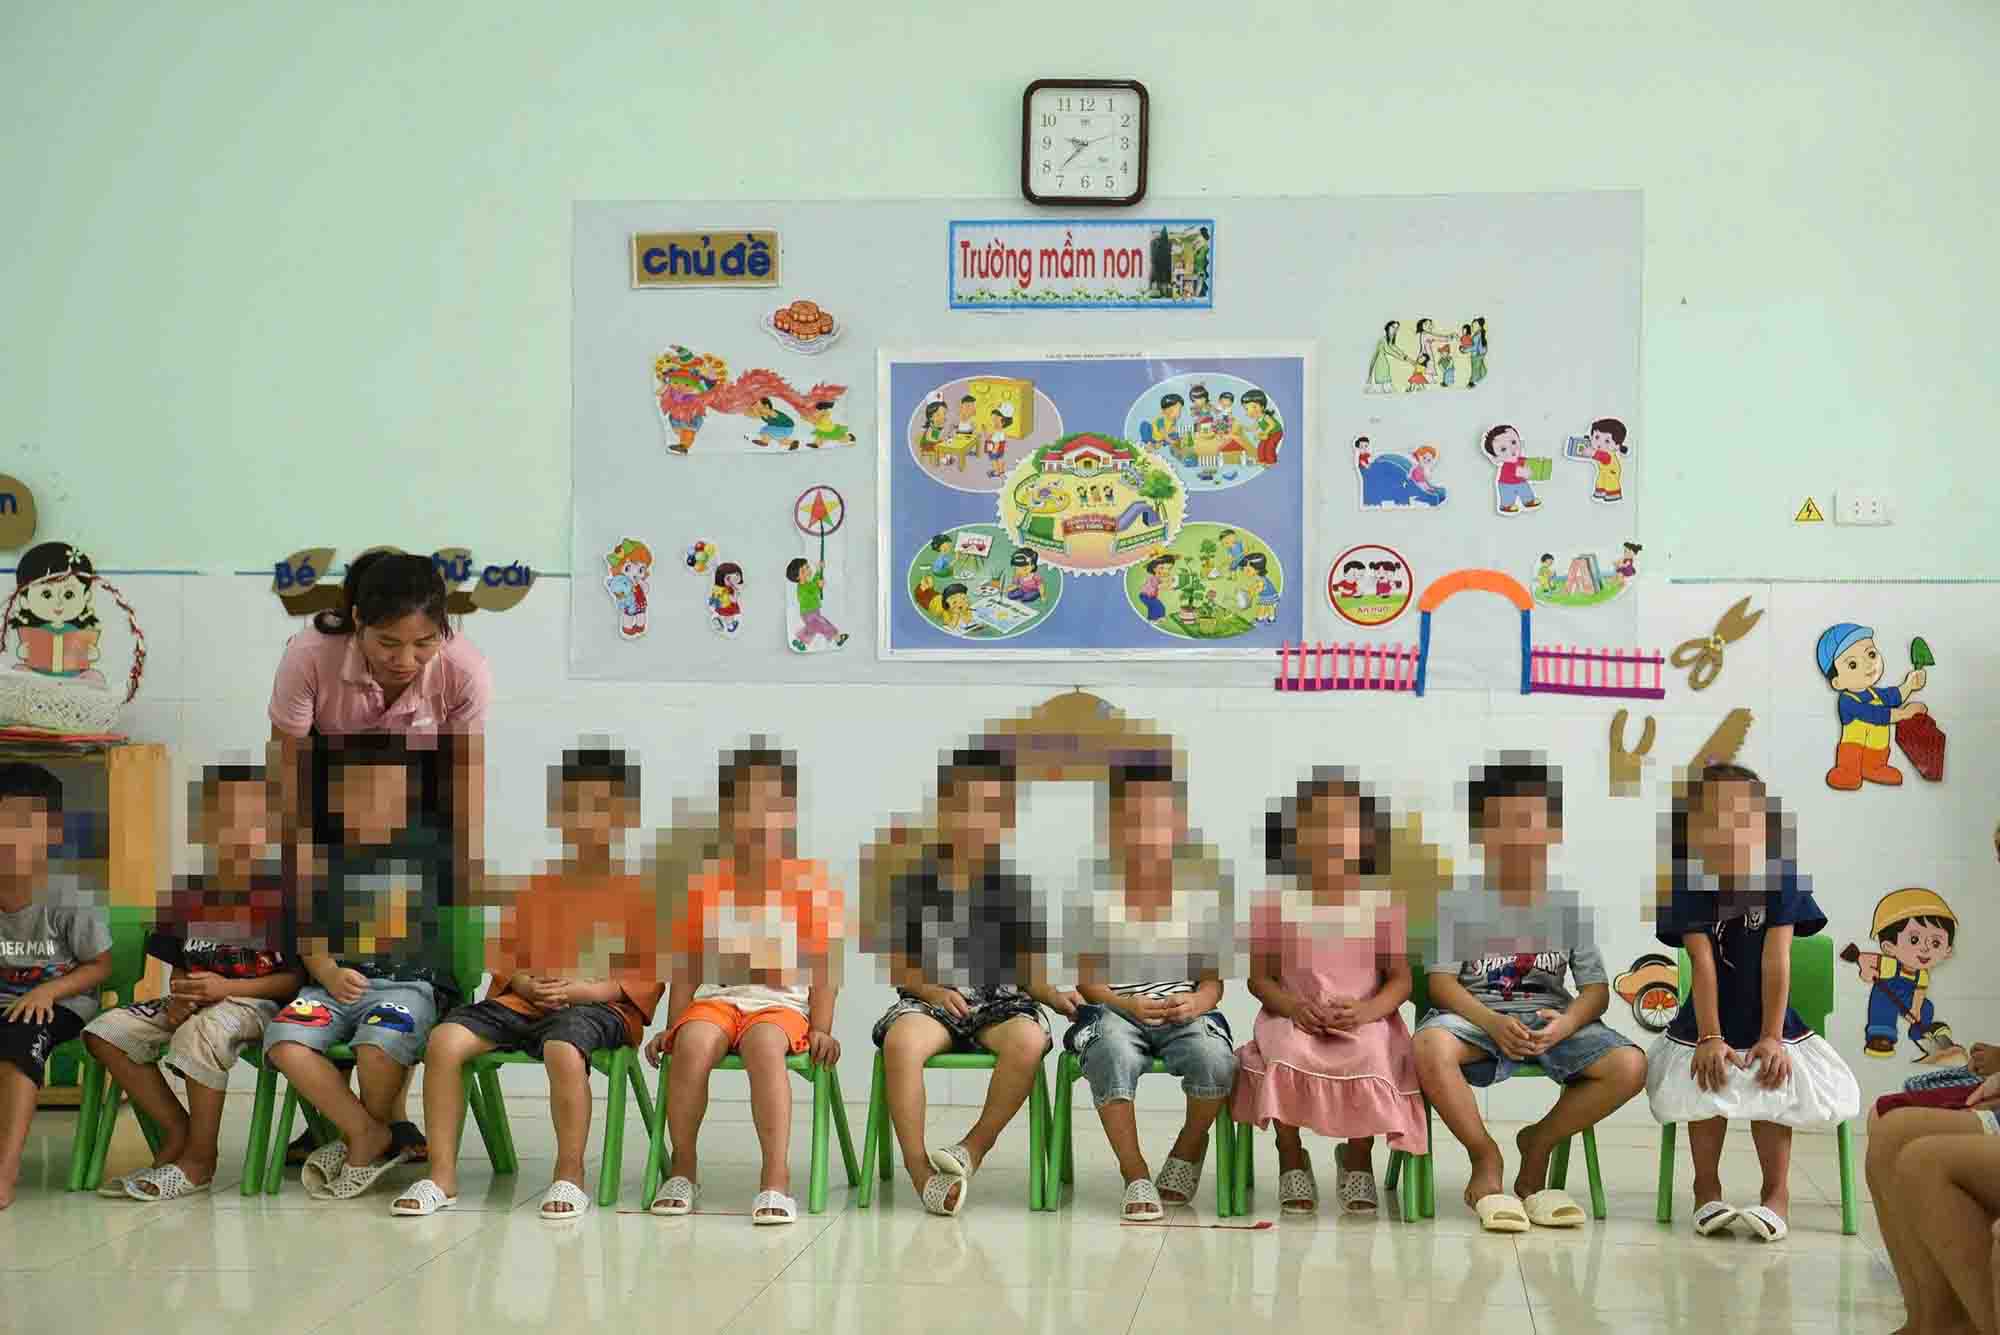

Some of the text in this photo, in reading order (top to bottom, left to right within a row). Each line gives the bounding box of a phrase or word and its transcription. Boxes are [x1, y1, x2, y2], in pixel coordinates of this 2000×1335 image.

[1056, 98, 1114, 112] 11 12 1
[1040, 113, 1056, 127] 10
[1120, 114, 1130, 127] 2
[1042, 136, 1052, 150] 9
[1120, 137, 1129, 150] 3
[1042, 160, 1052, 175] 8
[1120, 160, 1129, 175] 4
[1056, 175, 1114, 189] 7 6 5
[642, 235, 715, 276] chủ
[960, 231, 1143, 288] Trường mầm non
[274, 557, 316, 590] Bé
[483, 559, 529, 587] cái
